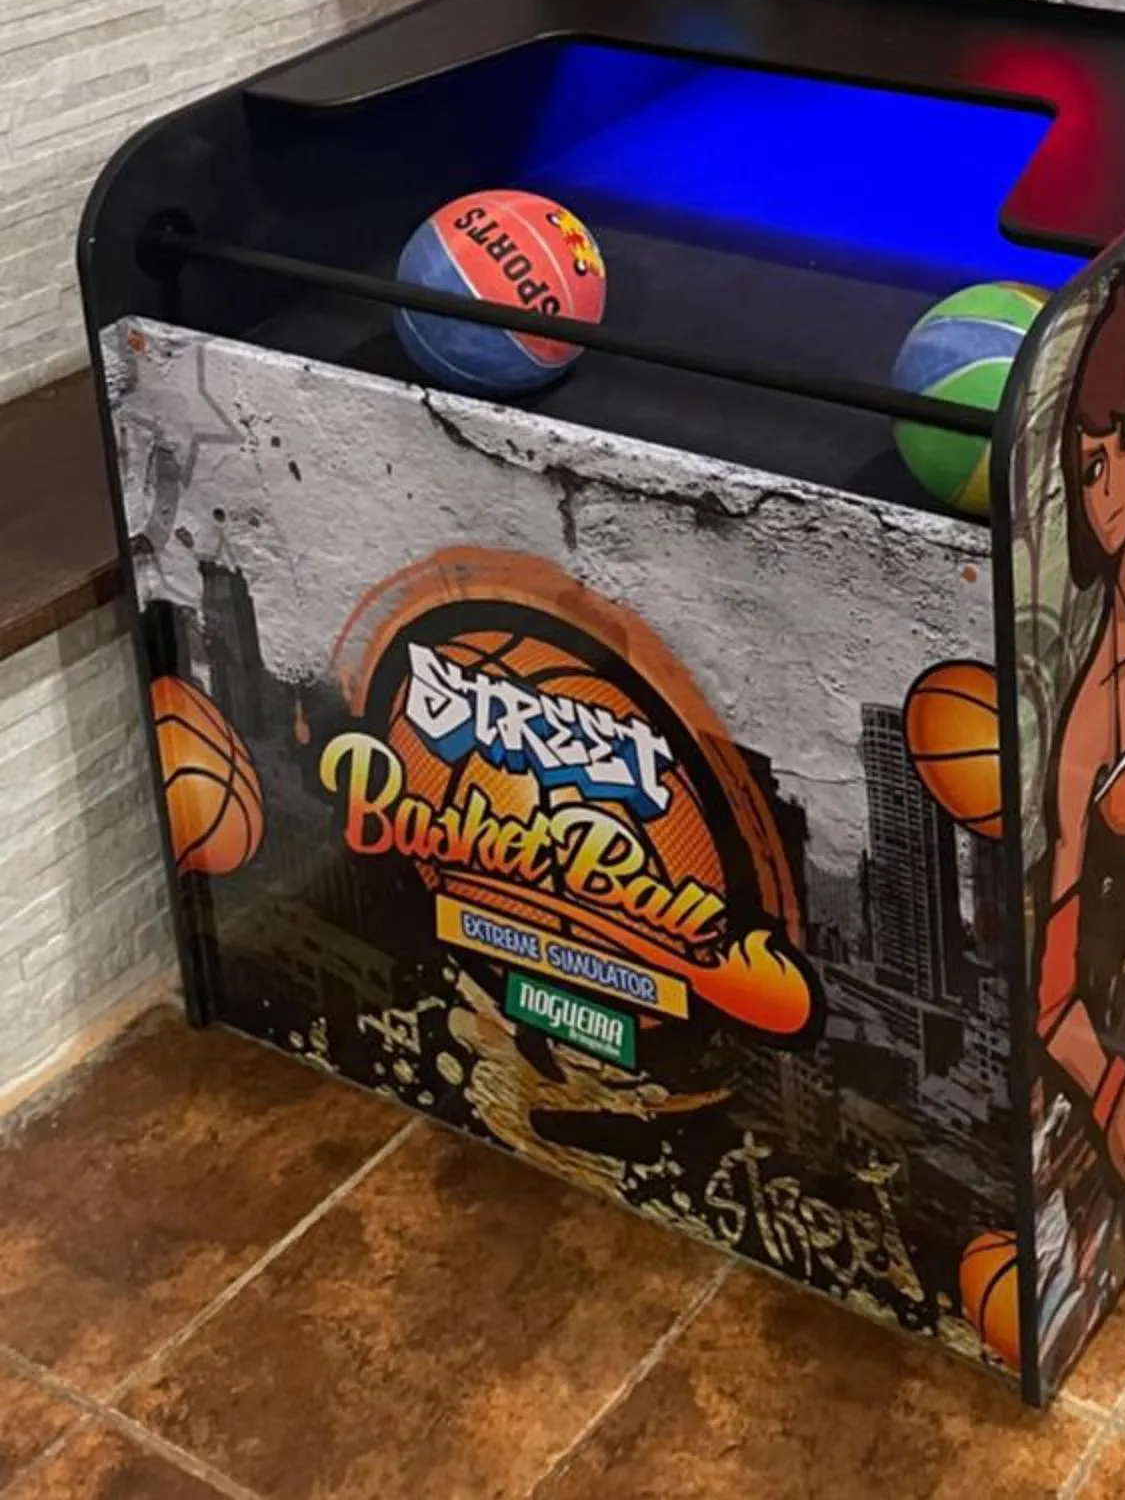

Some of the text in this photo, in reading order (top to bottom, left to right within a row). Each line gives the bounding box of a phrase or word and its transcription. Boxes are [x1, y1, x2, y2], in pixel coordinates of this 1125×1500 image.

[405, 643, 674, 810] STREET
[319, 731, 728, 940] Basket Ball
[462, 911, 657, 1003] EXTREME SIMULATOR
[520, 982, 624, 1048] NOGUEIRA
